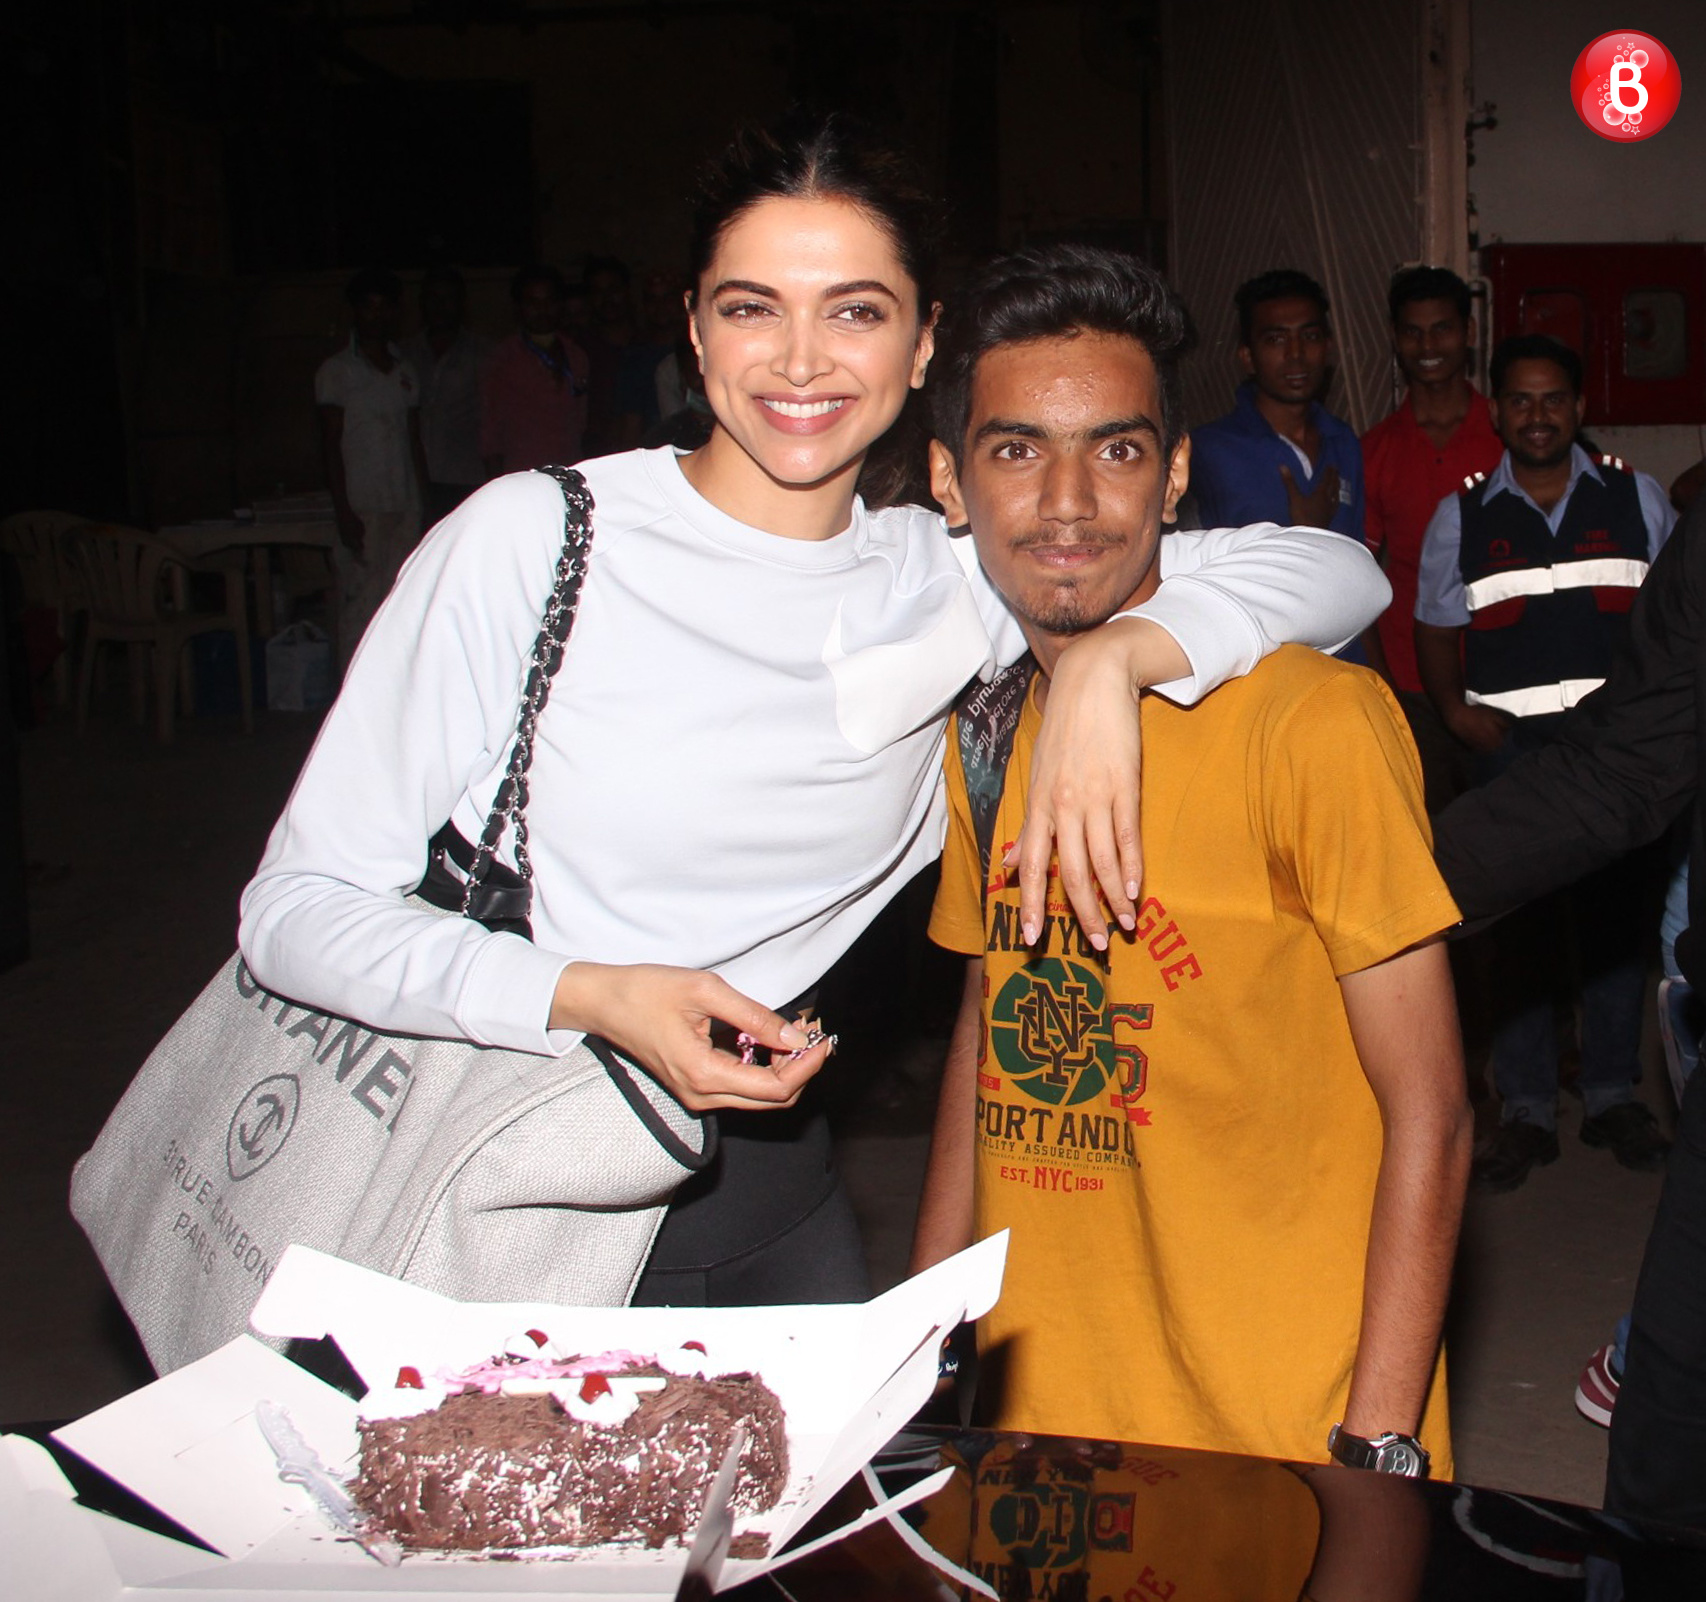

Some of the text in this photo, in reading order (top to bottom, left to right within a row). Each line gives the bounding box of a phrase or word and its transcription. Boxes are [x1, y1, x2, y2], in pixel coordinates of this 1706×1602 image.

[1135, 897, 1203, 992] GUE
[979, 1136, 1015, 1152] ALITY
[1024, 1143, 1080, 1161] ASSURED
[1057, 1112, 1119, 1152] AND
[171, 1156, 213, 1205] RUE
[1000, 1166, 1104, 1192] EST. NYC 1931
